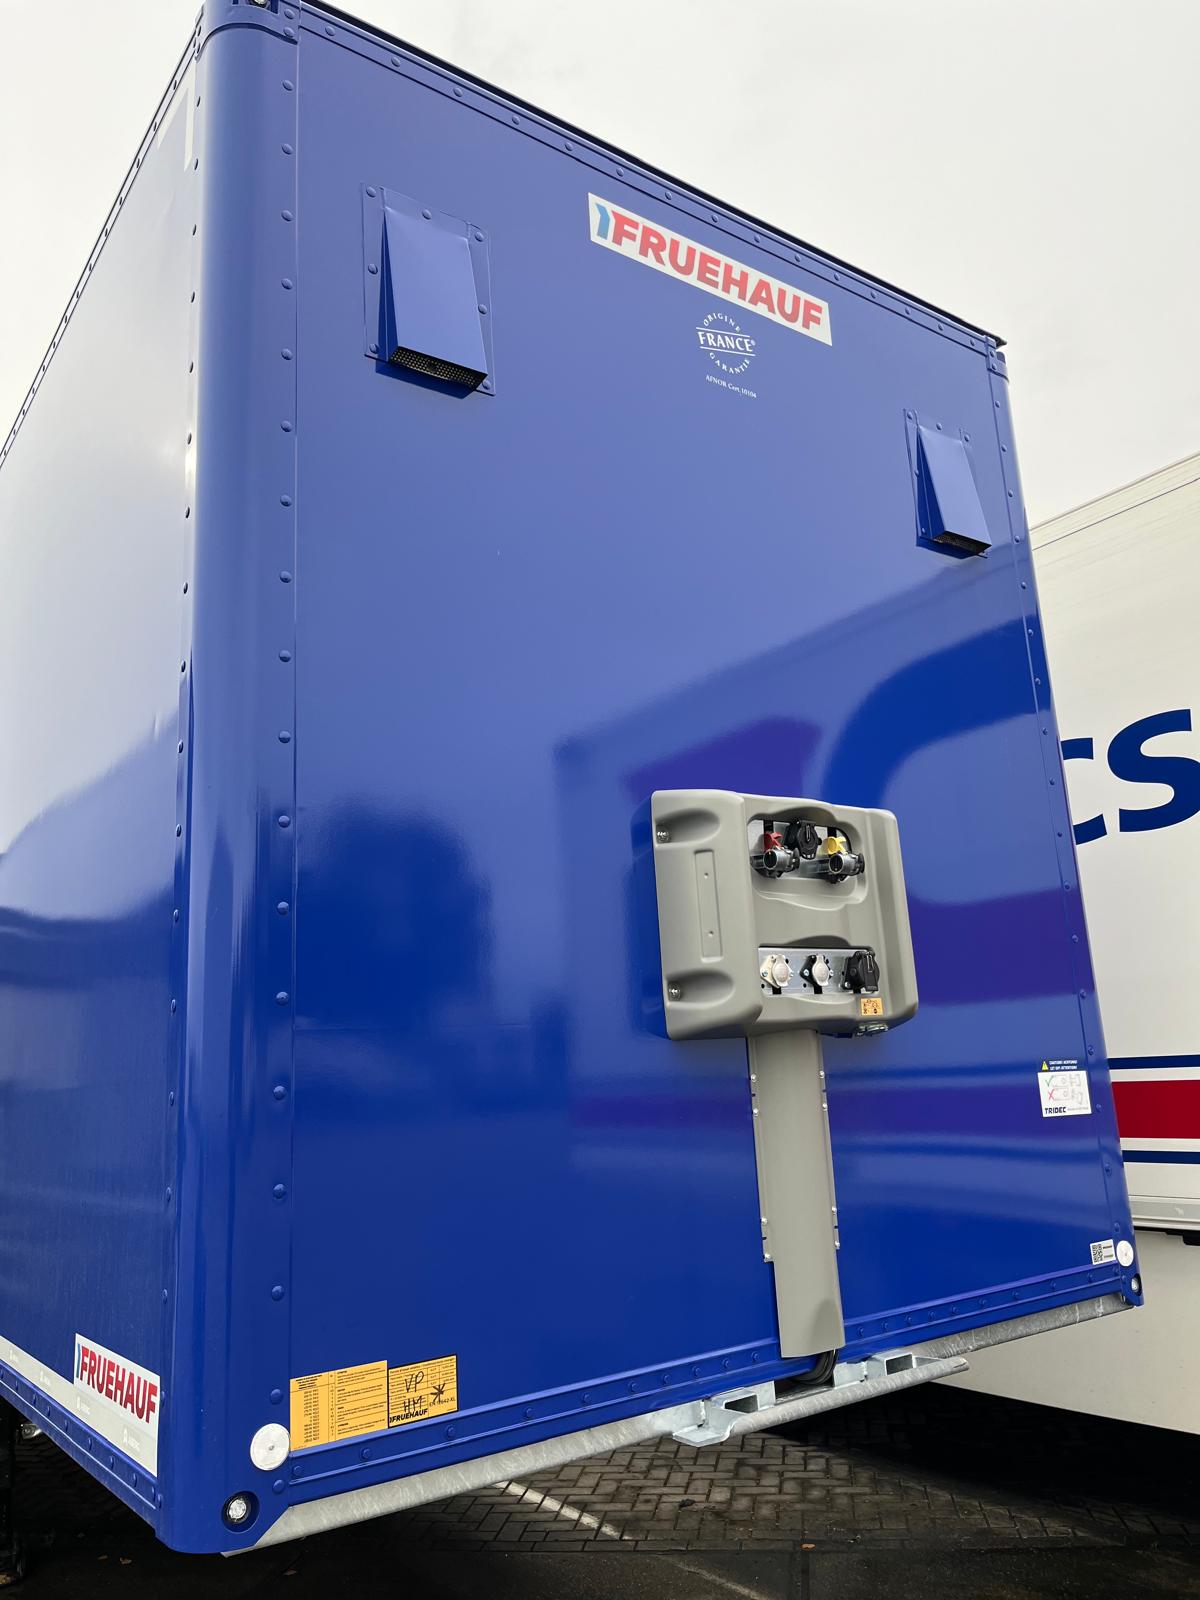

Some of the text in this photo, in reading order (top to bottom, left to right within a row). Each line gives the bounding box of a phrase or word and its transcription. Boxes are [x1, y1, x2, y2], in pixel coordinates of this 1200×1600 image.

[610, 209, 823, 330] FRUEHAUF
[1045, 1106, 1067, 1115] TRIDEC
[80, 1345, 158, 1424] FRUEHAUF
[392, 1408, 429, 1422] FRUEHAUF
